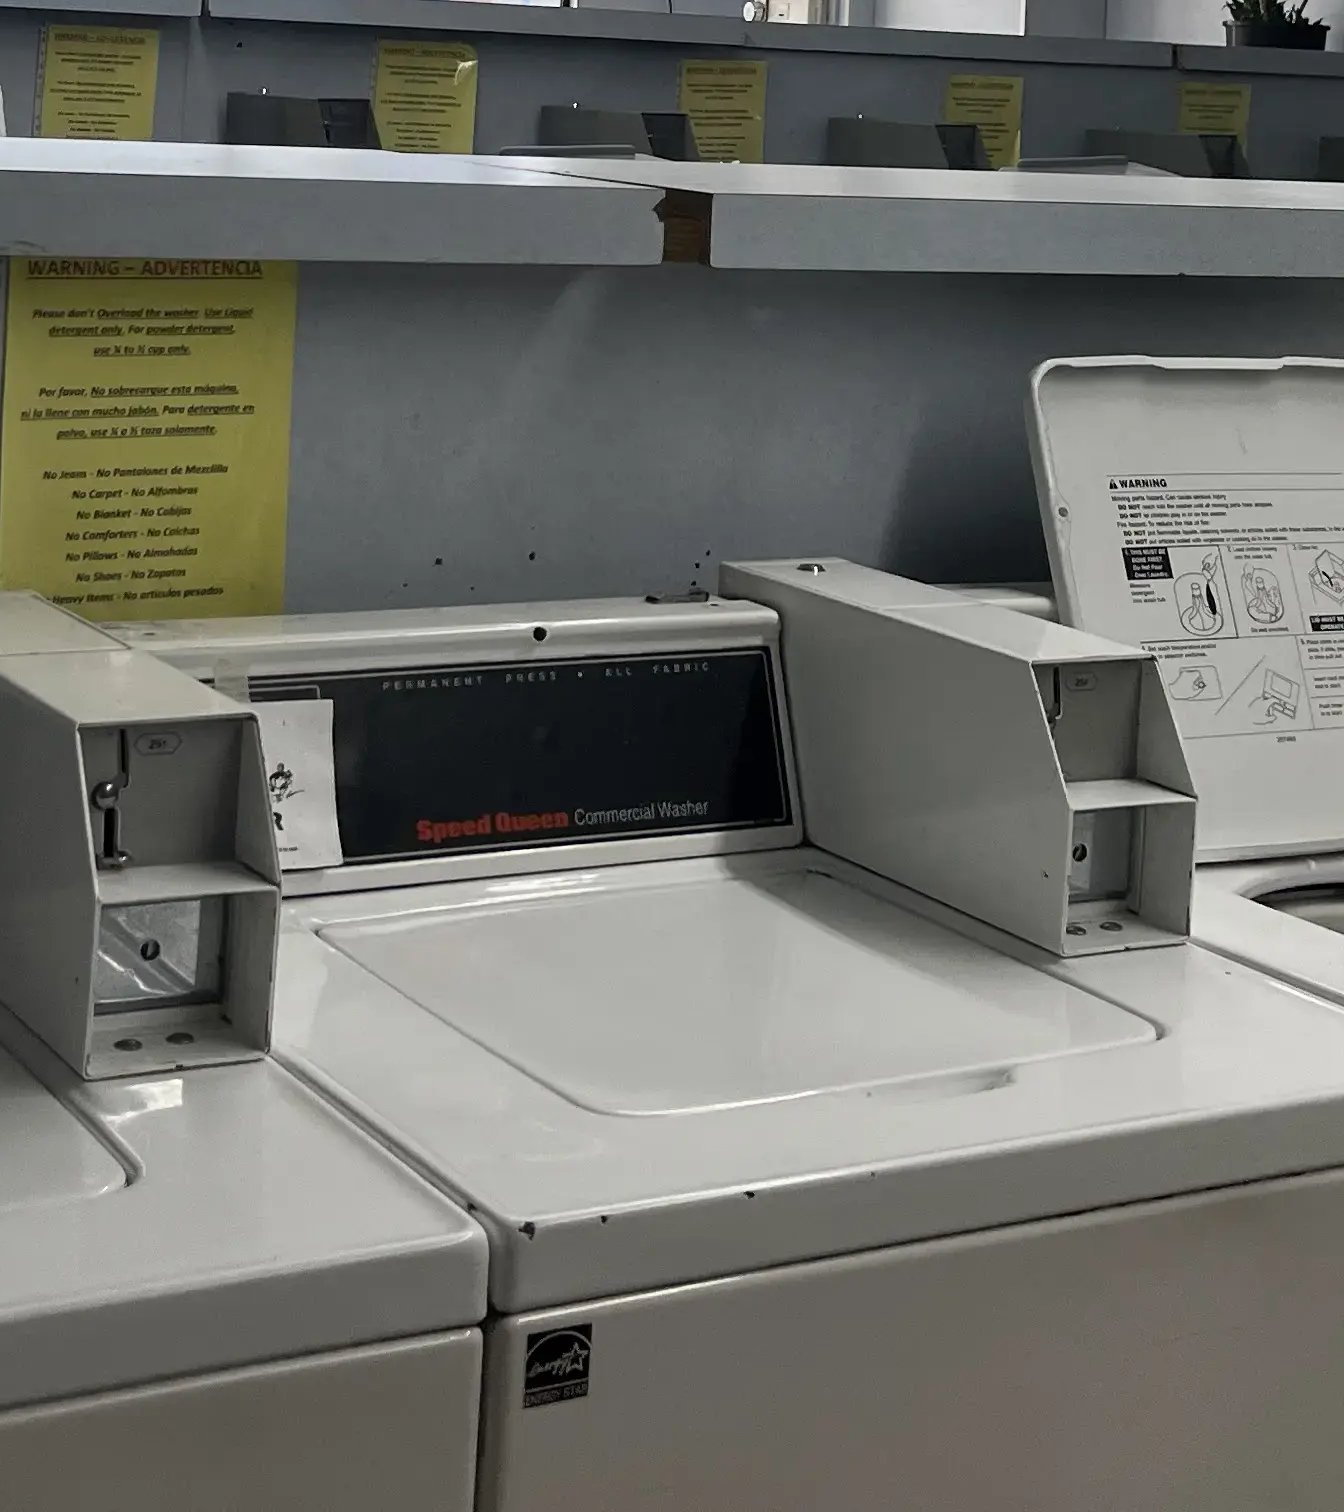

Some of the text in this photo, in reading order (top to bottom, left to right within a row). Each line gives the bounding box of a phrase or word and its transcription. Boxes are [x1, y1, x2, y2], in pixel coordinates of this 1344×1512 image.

[28, 260, 264, 276] WARNING ADVERTENCIA
[39, 387, 56, 397] Por
[90, 386, 105, 397] No
[92, 406, 126, 417] mucho
[162, 404, 185, 415] Para
[187, 403, 240, 416] detergente
[43, 471, 57, 480] No
[96, 469, 111, 478] No
[113, 467, 168, 478] Pantalones
[170, 465, 183, 475] de
[1119, 478, 1168, 489] WARNING
[72, 486, 198, 501] No Carpet No Alfombras
[76, 510, 91, 520] No
[93, 508, 132, 519] Blanket
[140, 508, 154, 517] No
[65, 532, 80, 541] No
[82, 529, 138, 542] Comforters
[147, 528, 161, 537] No
[65, 546, 198, 562] No Pillows No Almohadas
[76, 568, 186, 582] No Shoes No Zapatos
[123, 591, 137, 601] No
[183, 586, 224, 599] pesados
[383, 661, 709, 691] PERMANENT PRESS ALL FABRIC
[416, 799, 709, 843] Speed Queen Commercial Washer
